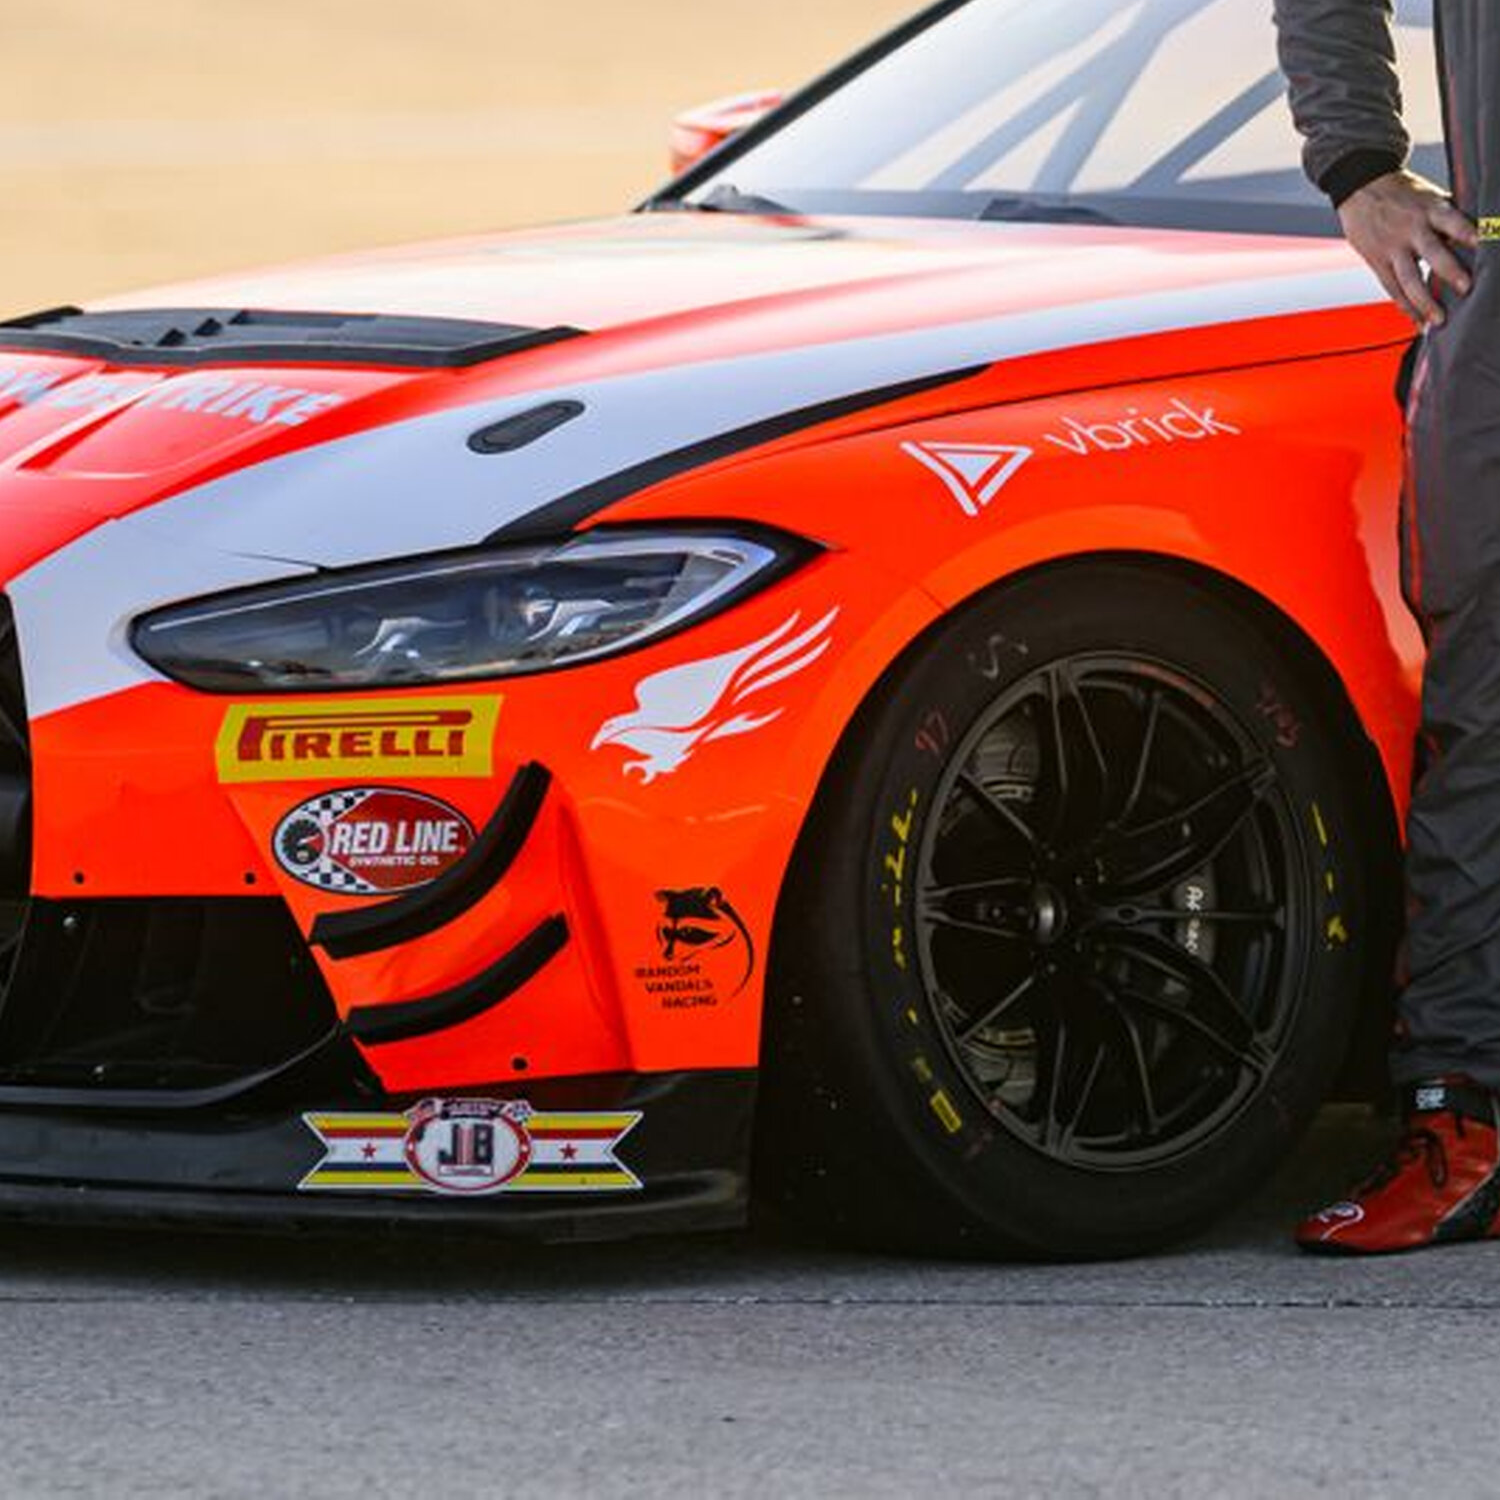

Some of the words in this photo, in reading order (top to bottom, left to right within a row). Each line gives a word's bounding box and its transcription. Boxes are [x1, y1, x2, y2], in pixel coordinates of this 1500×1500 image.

[1044, 398, 1241, 455] vbrick
[238, 710, 472, 761] PIRELLI
[331, 821, 389, 855] RED
[394, 820, 459, 854] LINE
[349, 855, 416, 867] SYNTHETIC
[419, 855, 440, 866] OIL
